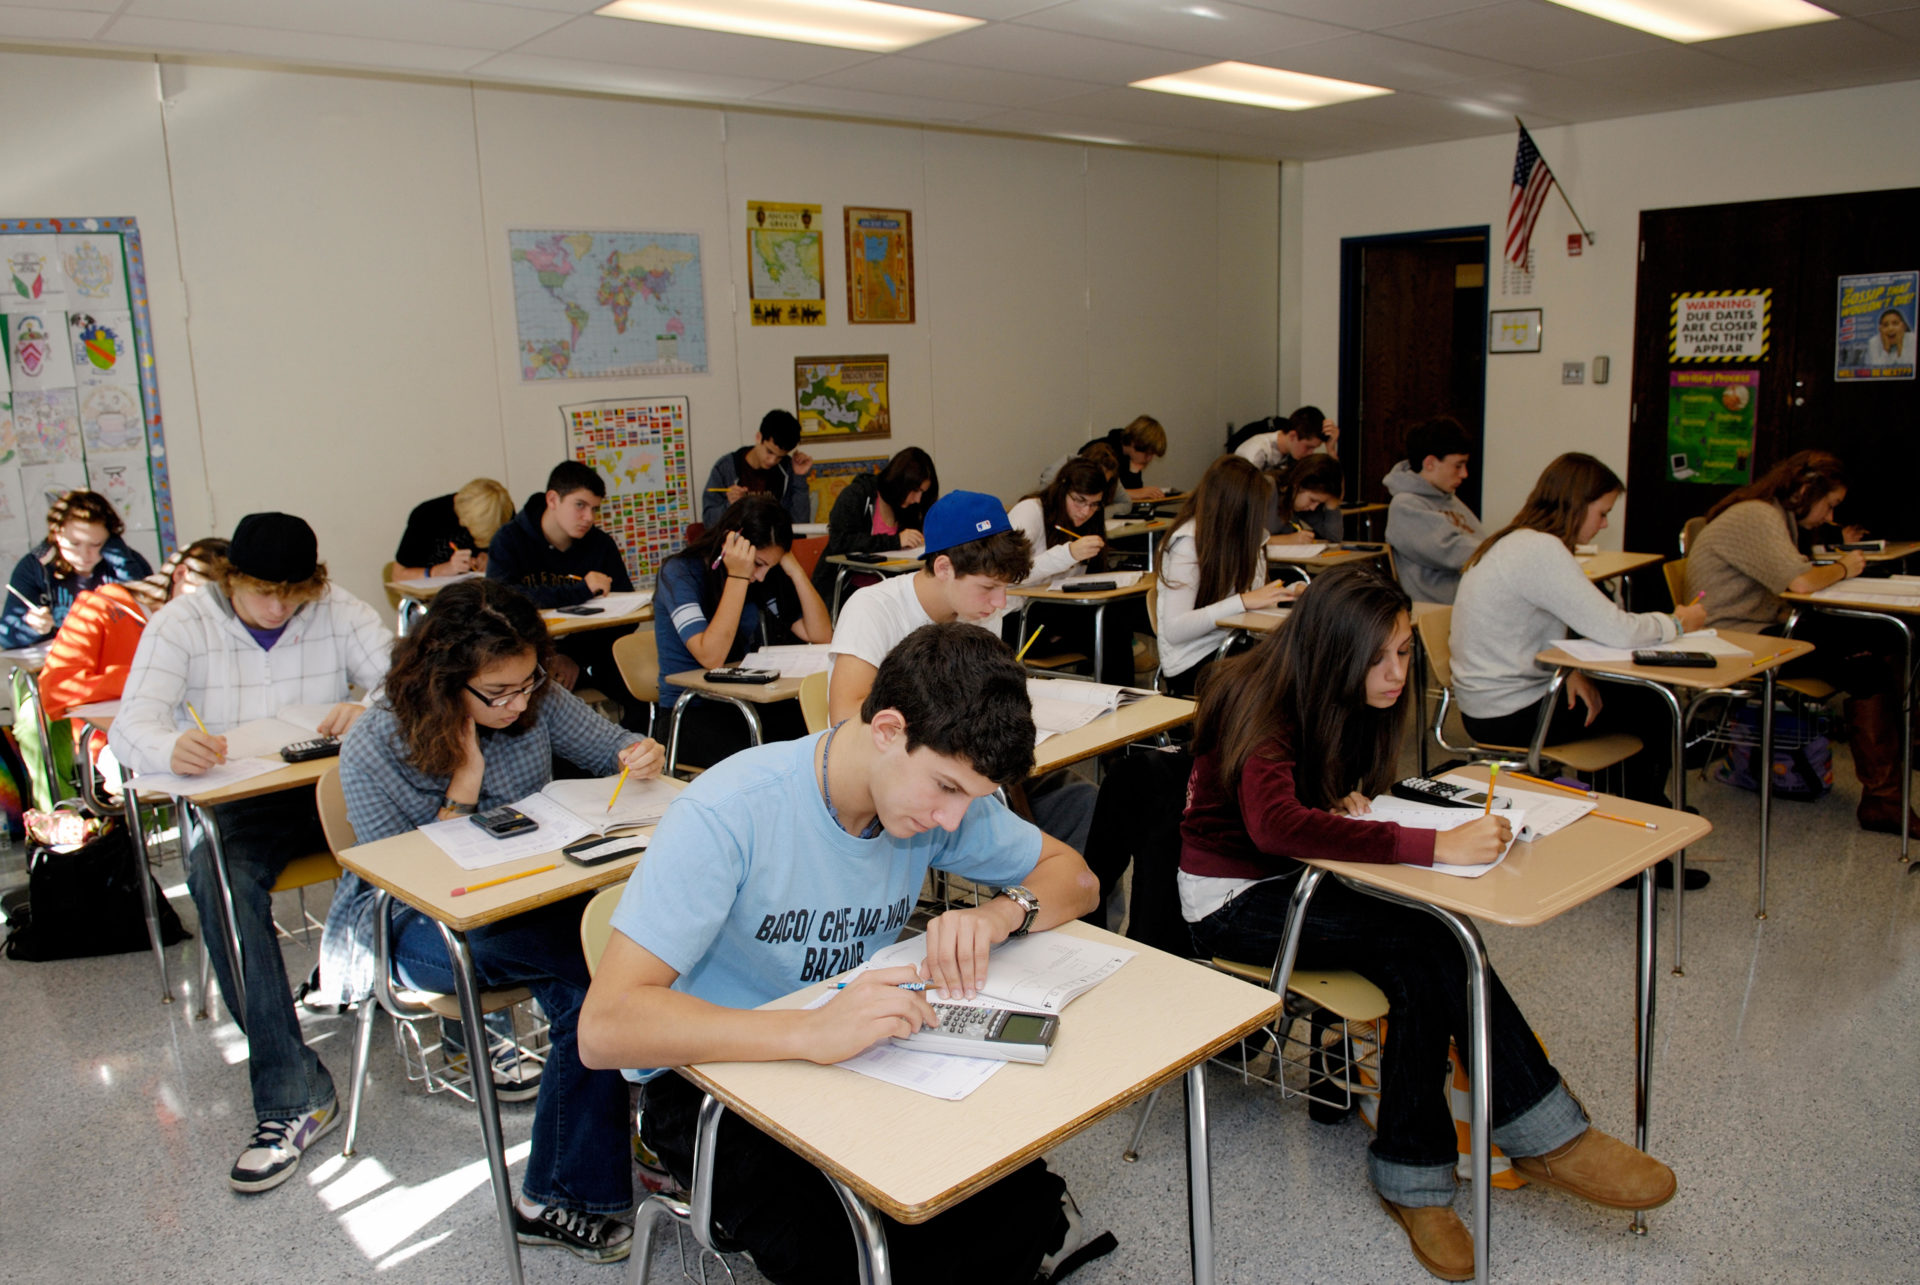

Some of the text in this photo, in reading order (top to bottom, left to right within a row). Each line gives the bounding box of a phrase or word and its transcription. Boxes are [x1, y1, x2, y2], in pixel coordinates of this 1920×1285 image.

[1842, 286, 1885, 307] GOSSIP
[1686, 299, 1756, 310] WARNING:
[1687, 310, 1753, 321] DUE DATES
[1682, 322, 1757, 332] ARE CLOSER
[1684, 333, 1754, 342] THAN THEY
[1694, 344, 1742, 353] APPEAR
[1677, 373, 1750, 384] Writing Process
[800, 941, 864, 981] BAZAAR
